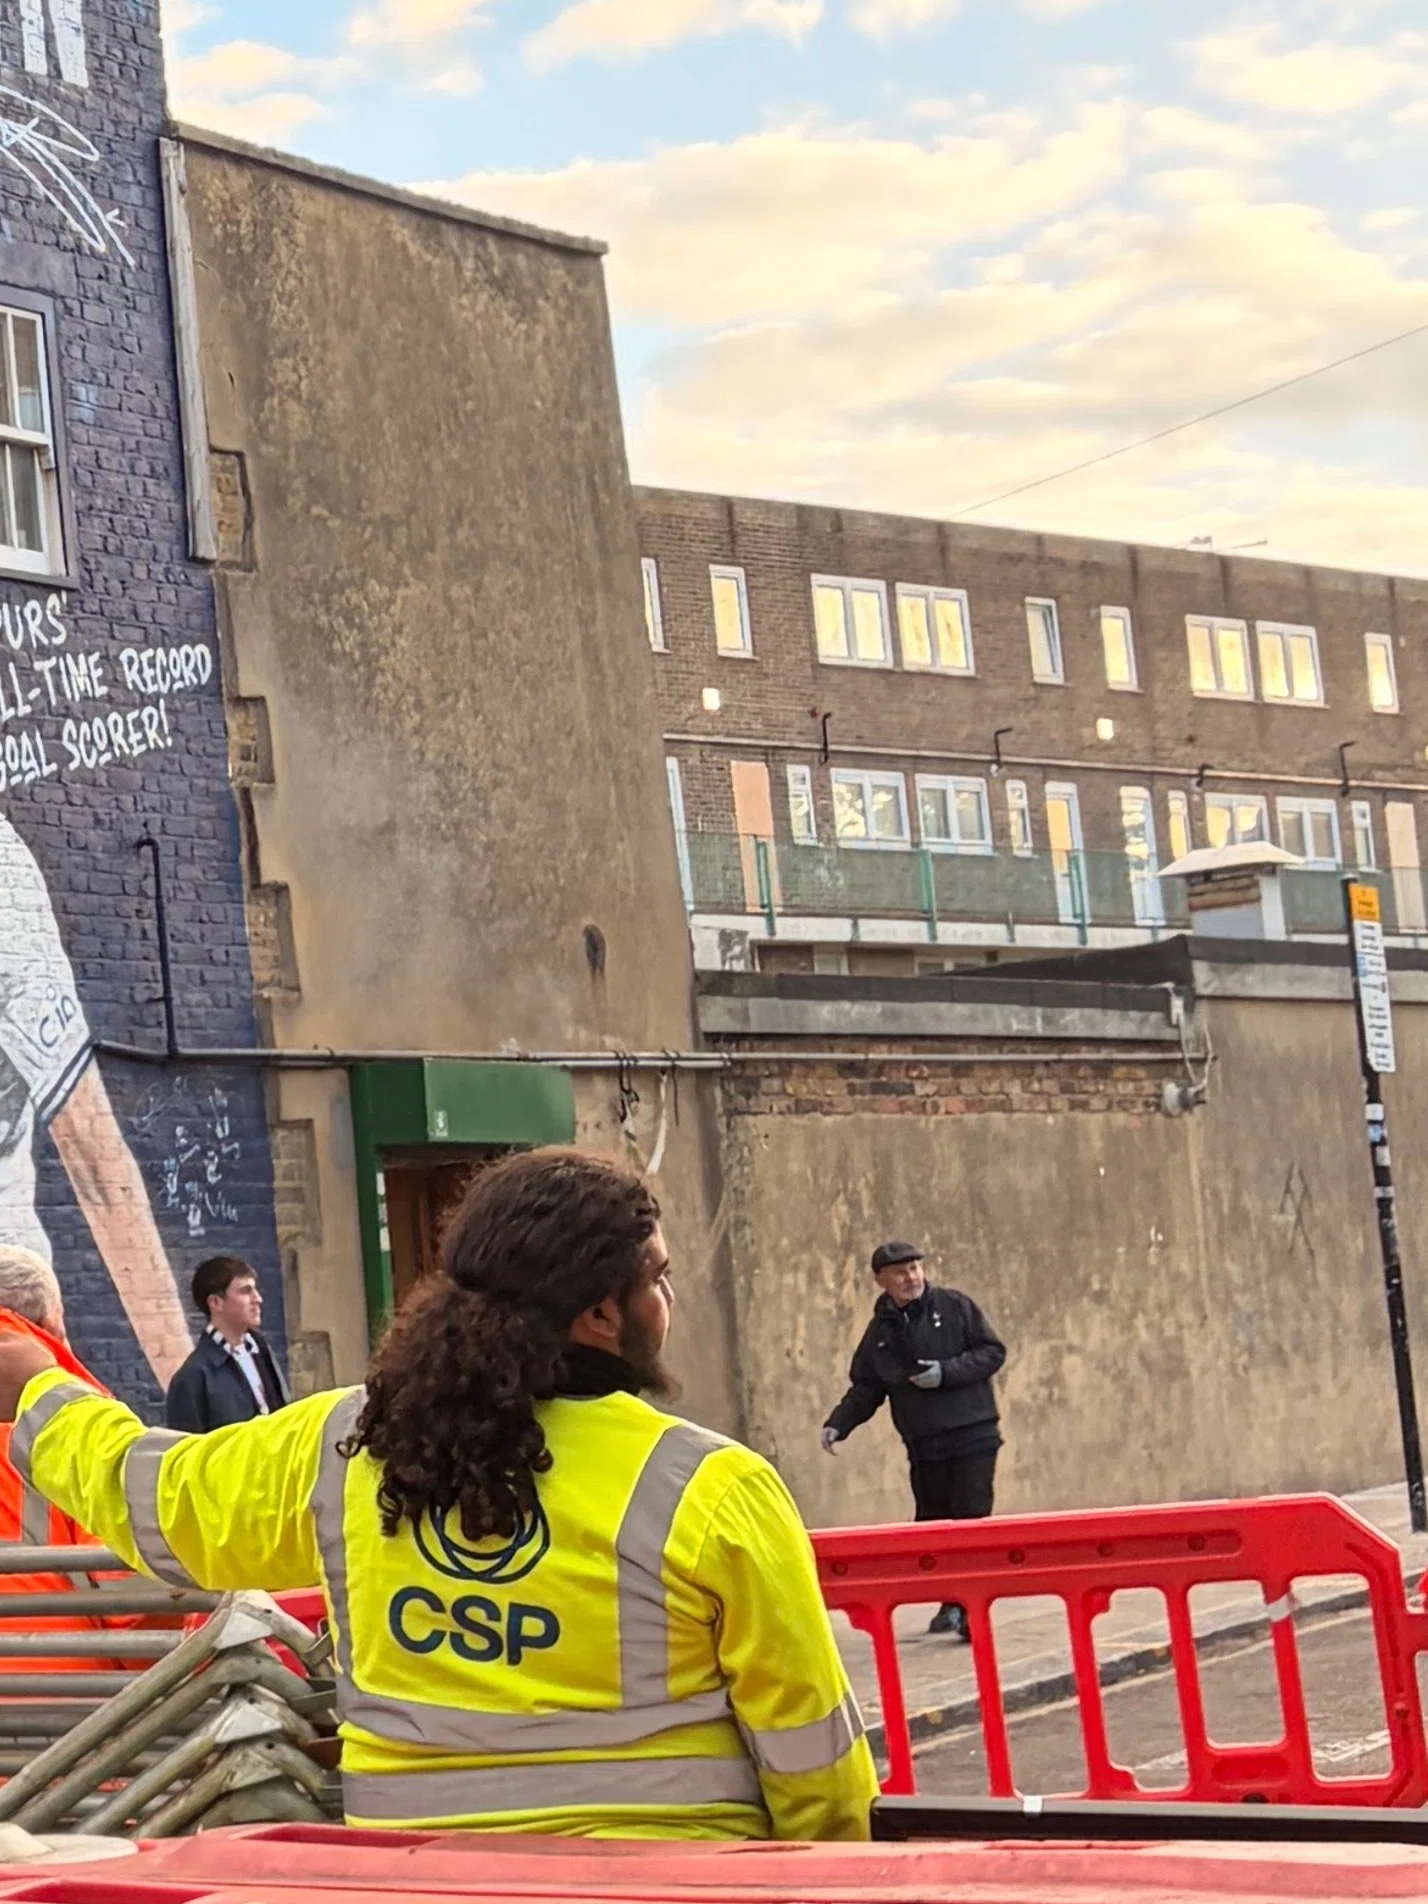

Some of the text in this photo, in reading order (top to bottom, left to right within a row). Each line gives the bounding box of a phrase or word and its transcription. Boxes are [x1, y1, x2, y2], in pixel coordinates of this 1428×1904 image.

[119, 644, 212, 695] RECORD
[62, 698, 172, 771] SCORER!
[389, 1586, 560, 1666] CSP
